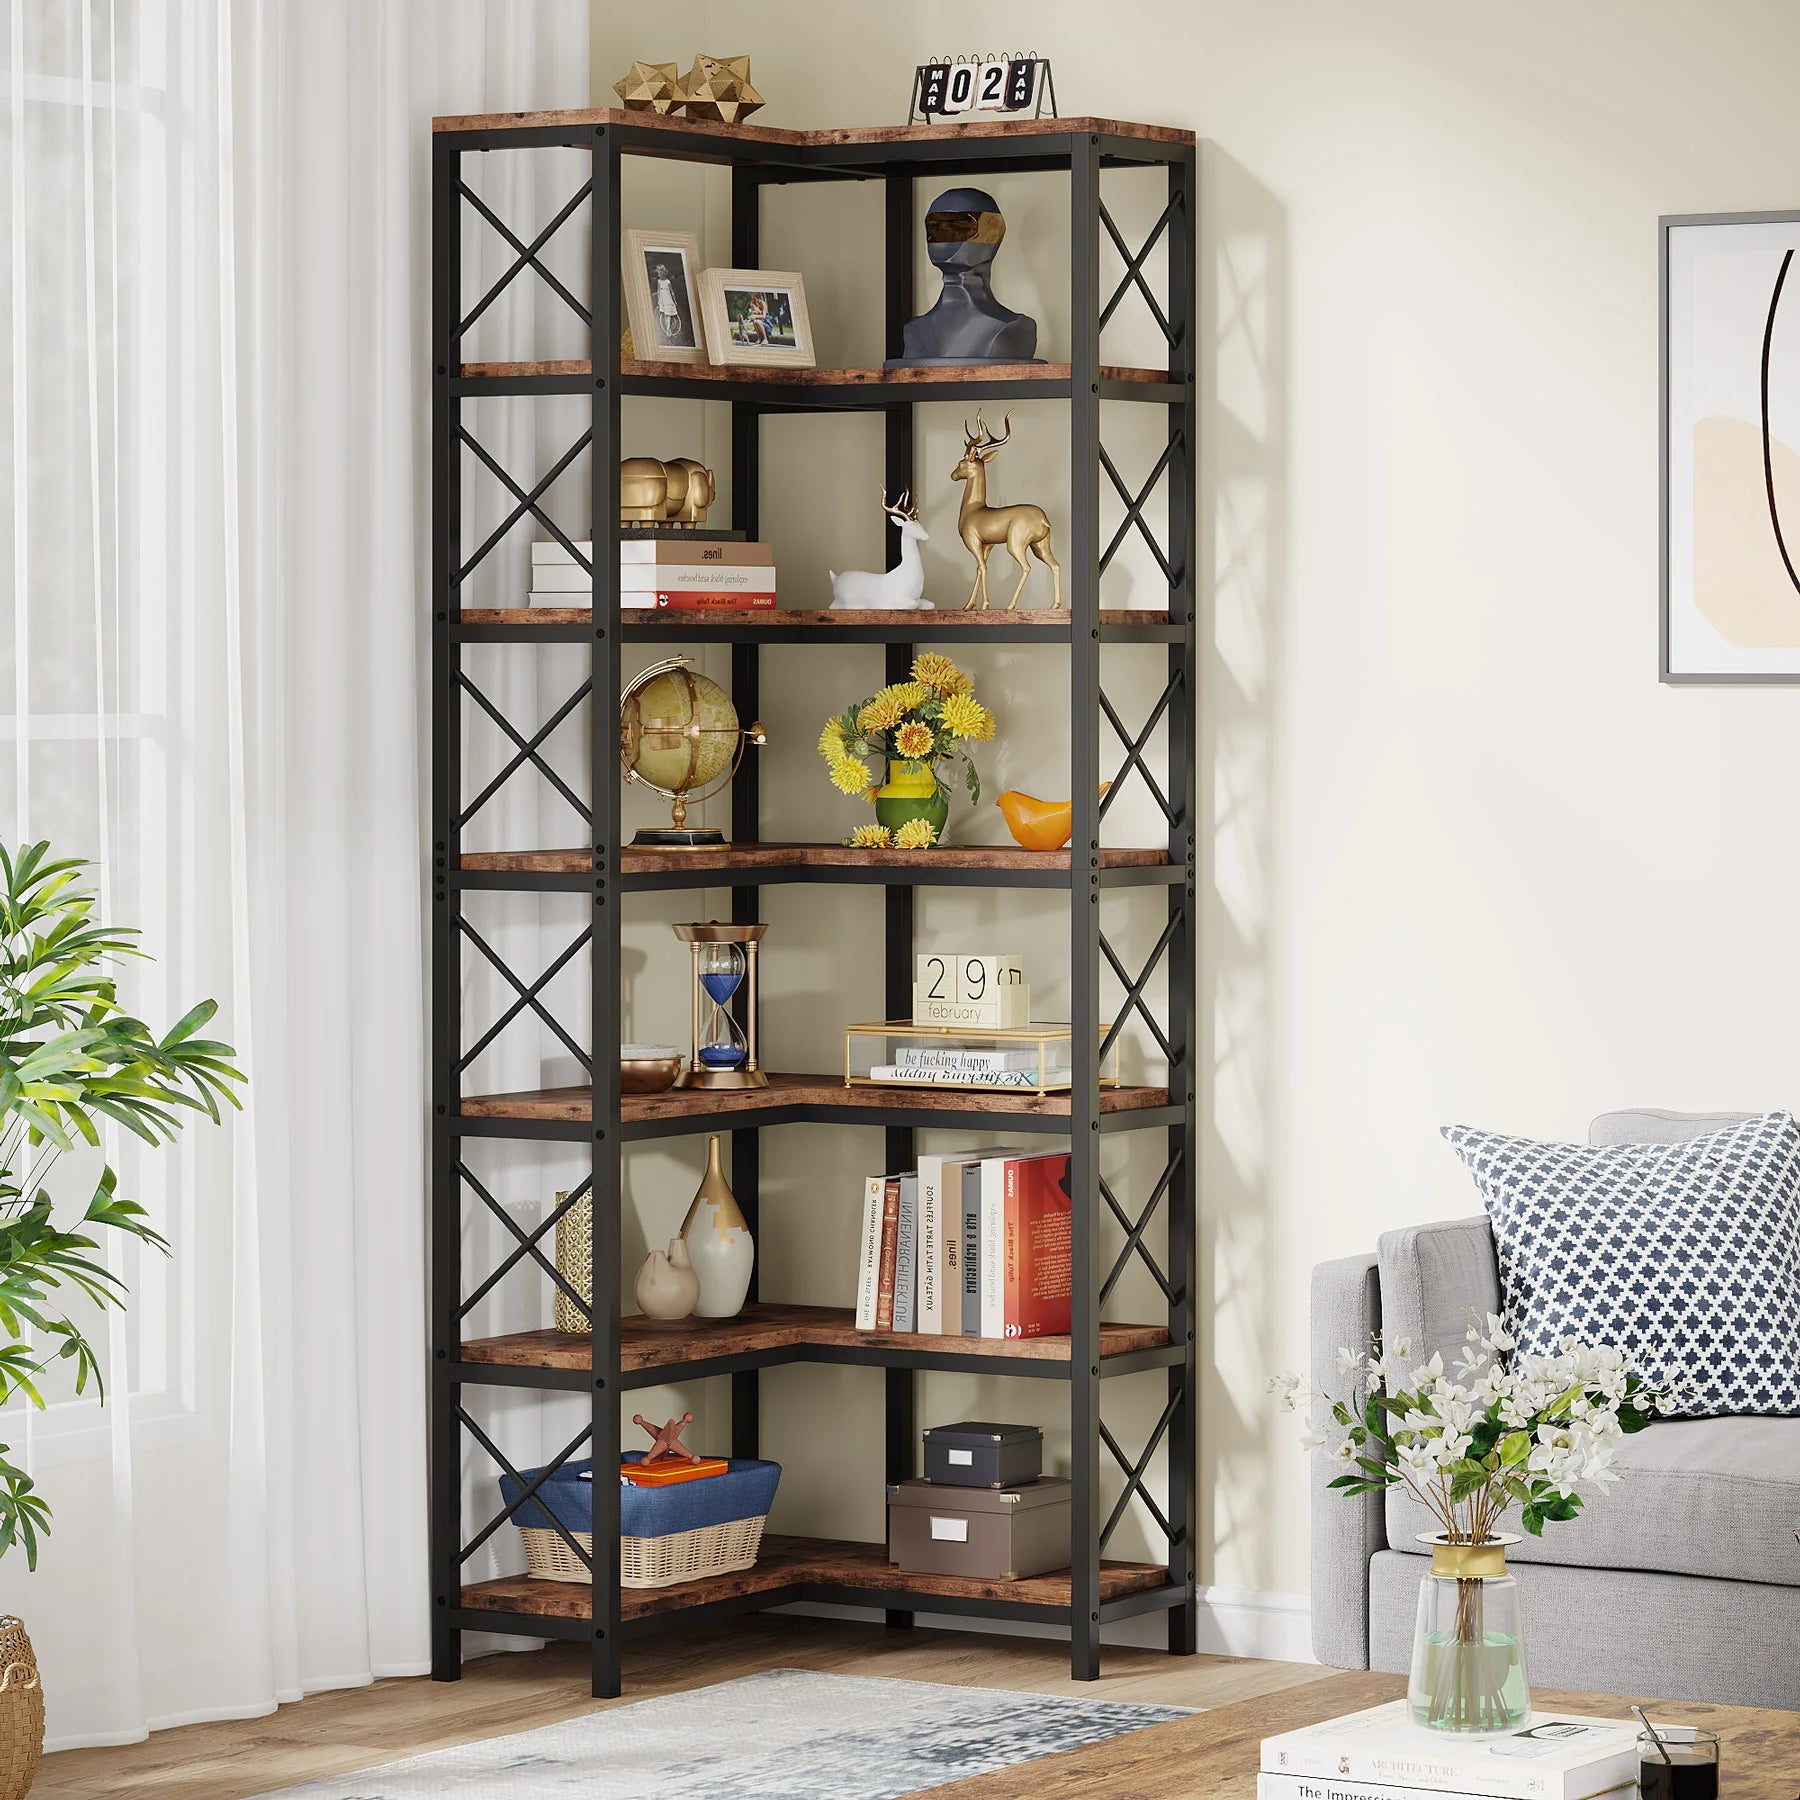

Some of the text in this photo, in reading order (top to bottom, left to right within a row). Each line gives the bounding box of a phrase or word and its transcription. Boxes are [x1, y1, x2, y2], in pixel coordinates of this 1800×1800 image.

[927, 70, 943, 106] MAR
[1014, 64, 1027, 101] JAN
[927, 958, 985, 1000] 29
[928, 1002, 981, 1023] february
[905, 1050, 991, 1071] be fucking happy
[891, 1068, 937, 1083] happy
[1369, 1759, 1458, 1777] ARCHITECTURE
[1298, 1786, 1322, 1799] The
